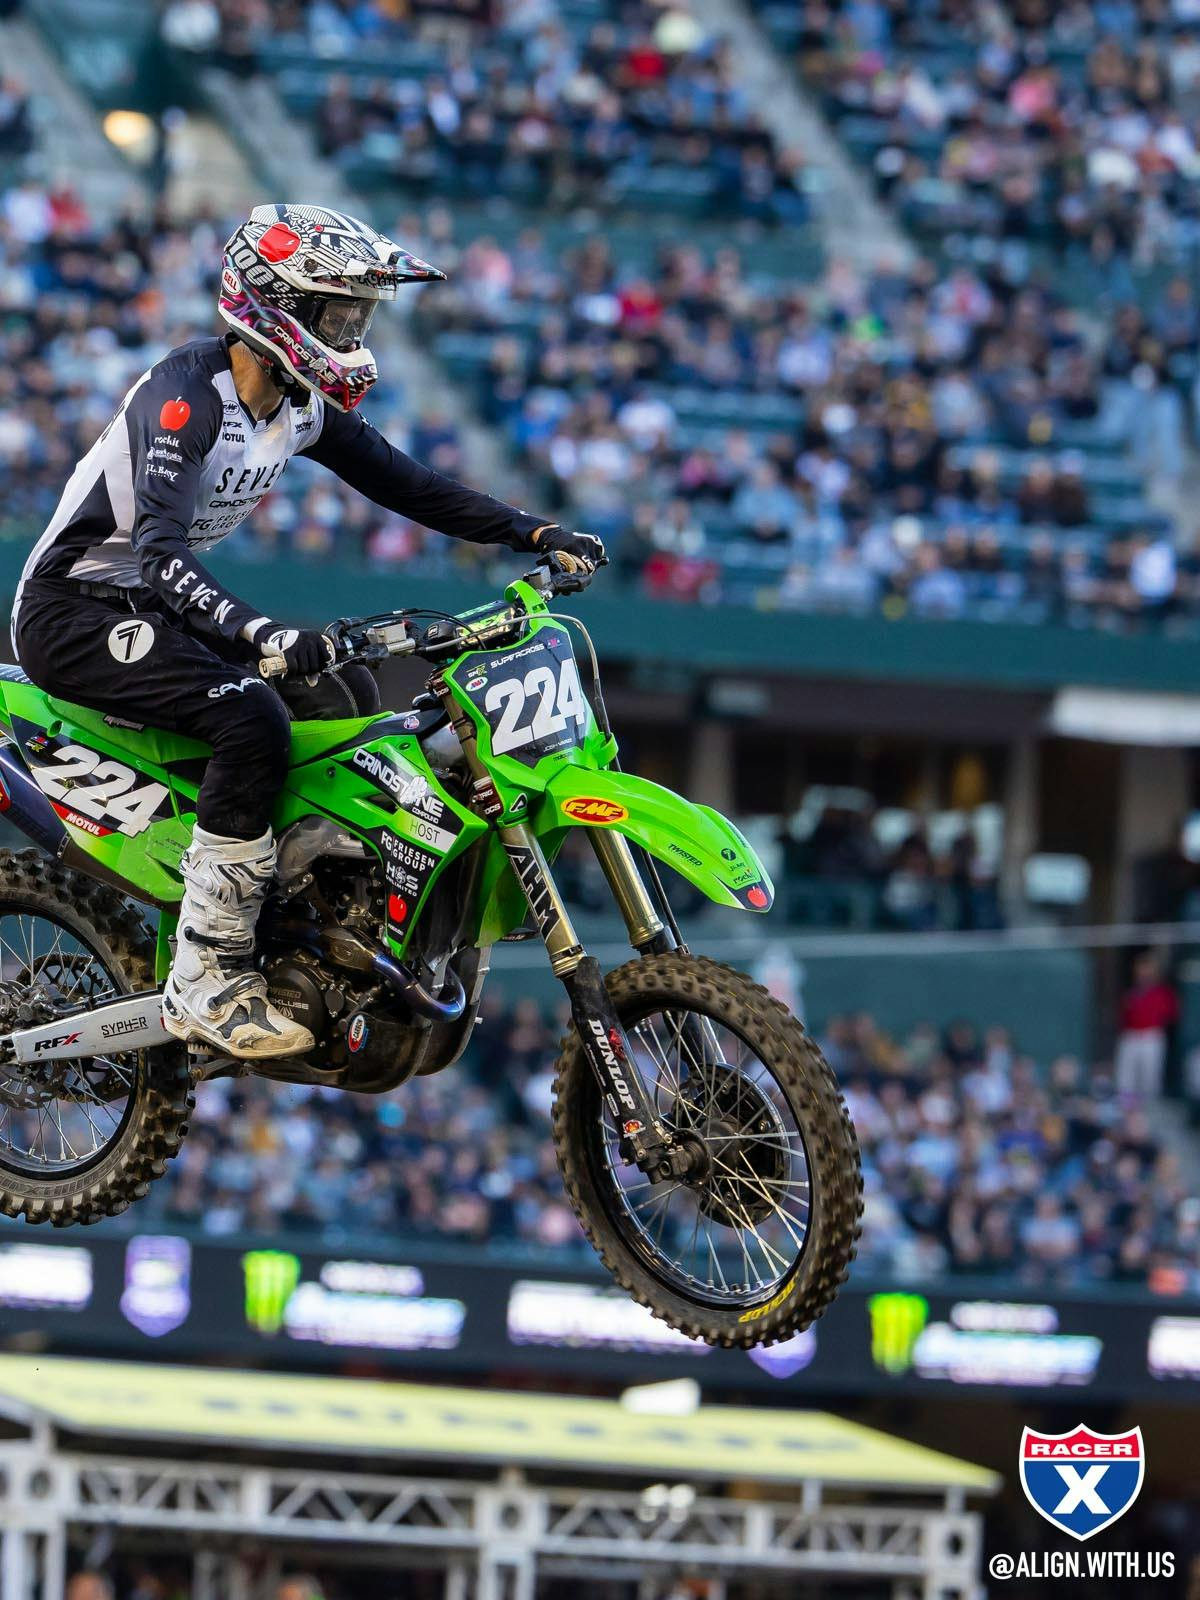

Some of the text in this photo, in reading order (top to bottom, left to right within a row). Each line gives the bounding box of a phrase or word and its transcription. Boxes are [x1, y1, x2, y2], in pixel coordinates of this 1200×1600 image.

[223, 272, 238, 291] BELL
[154, 435, 180, 448] rockit
[222, 432, 246, 443] OTUL
[215, 459, 289, 494] SEVE
[161, 558, 236, 624] SEVEN
[485, 658, 585, 756] 224
[31, 745, 170, 838] 224
[566, 802, 623, 817] FMF
[66, 812, 101, 836] MOTUL
[410, 822, 441, 843] HOST
[381, 830, 435, 868] FG FRIESEN
[393, 848, 426, 872] GROUP
[668, 843, 702, 866] TWISTED
[385, 874, 417, 897] UNLIMITED
[101, 1017, 148, 1036] SYPHER
[34, 1032, 84, 1052] RFX
[589, 1020, 635, 1109] DUNLOP
